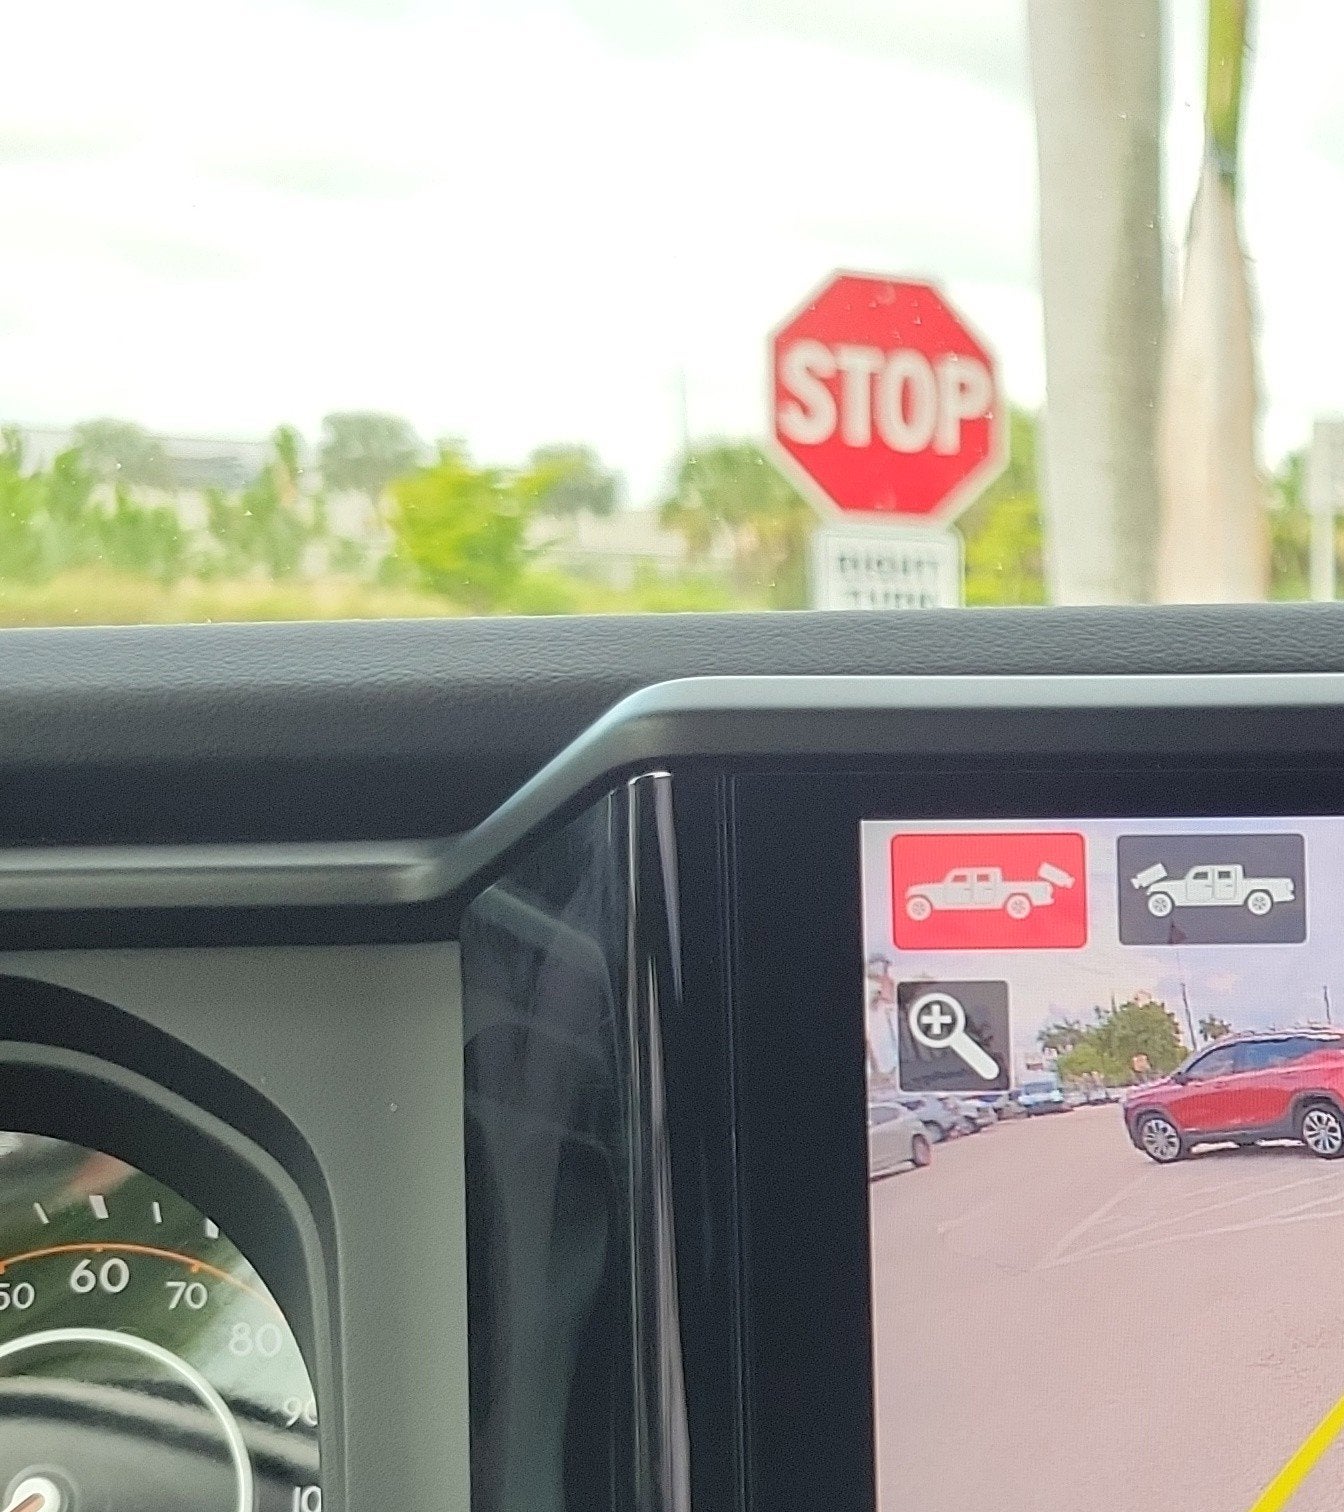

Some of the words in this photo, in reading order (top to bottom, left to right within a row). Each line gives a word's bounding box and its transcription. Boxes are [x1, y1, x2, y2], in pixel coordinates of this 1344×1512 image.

[777, 338, 990, 457] STOP
[70, 1257, 130, 1293] 60
[166, 1281, 208, 1311] 70
[228, 1322, 283, 1357] 80
